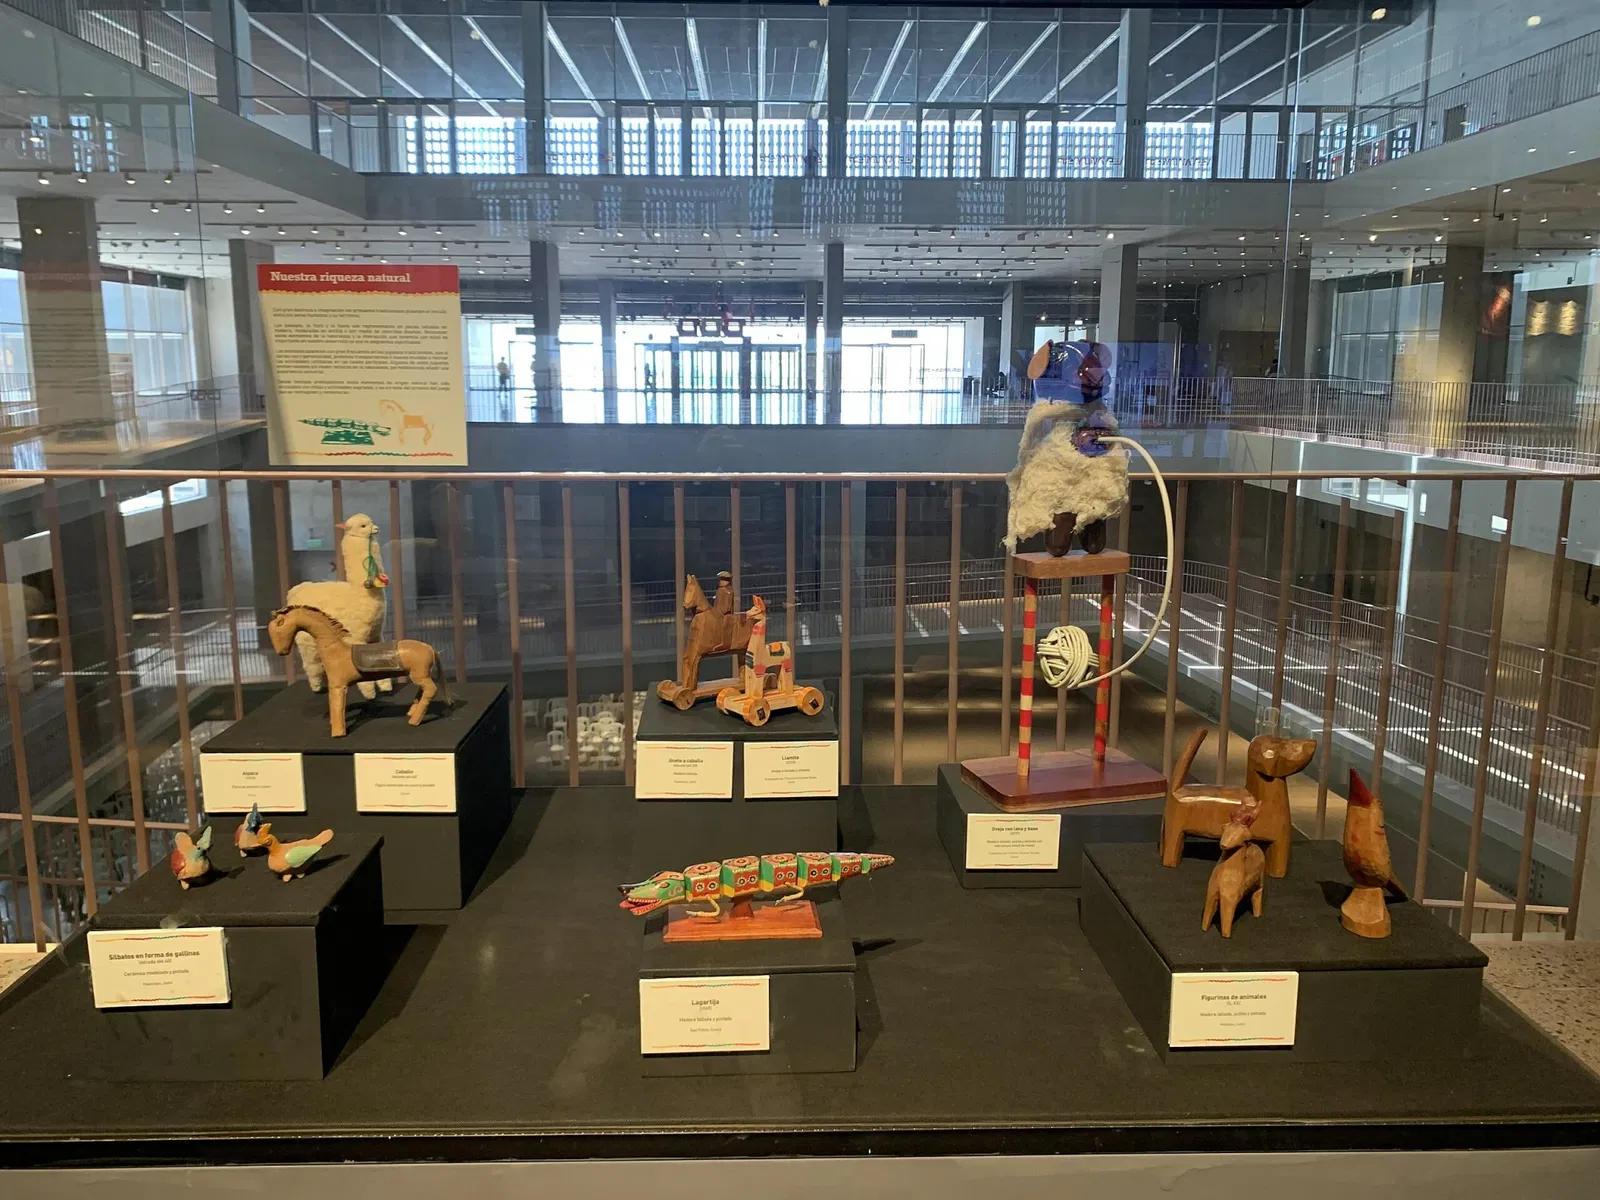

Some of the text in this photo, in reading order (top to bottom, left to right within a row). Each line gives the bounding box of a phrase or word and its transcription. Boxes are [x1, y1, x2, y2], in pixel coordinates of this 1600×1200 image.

[270, 271, 411, 284] Nuestra riqueza natural
[174, 950, 200, 958] gallinas
